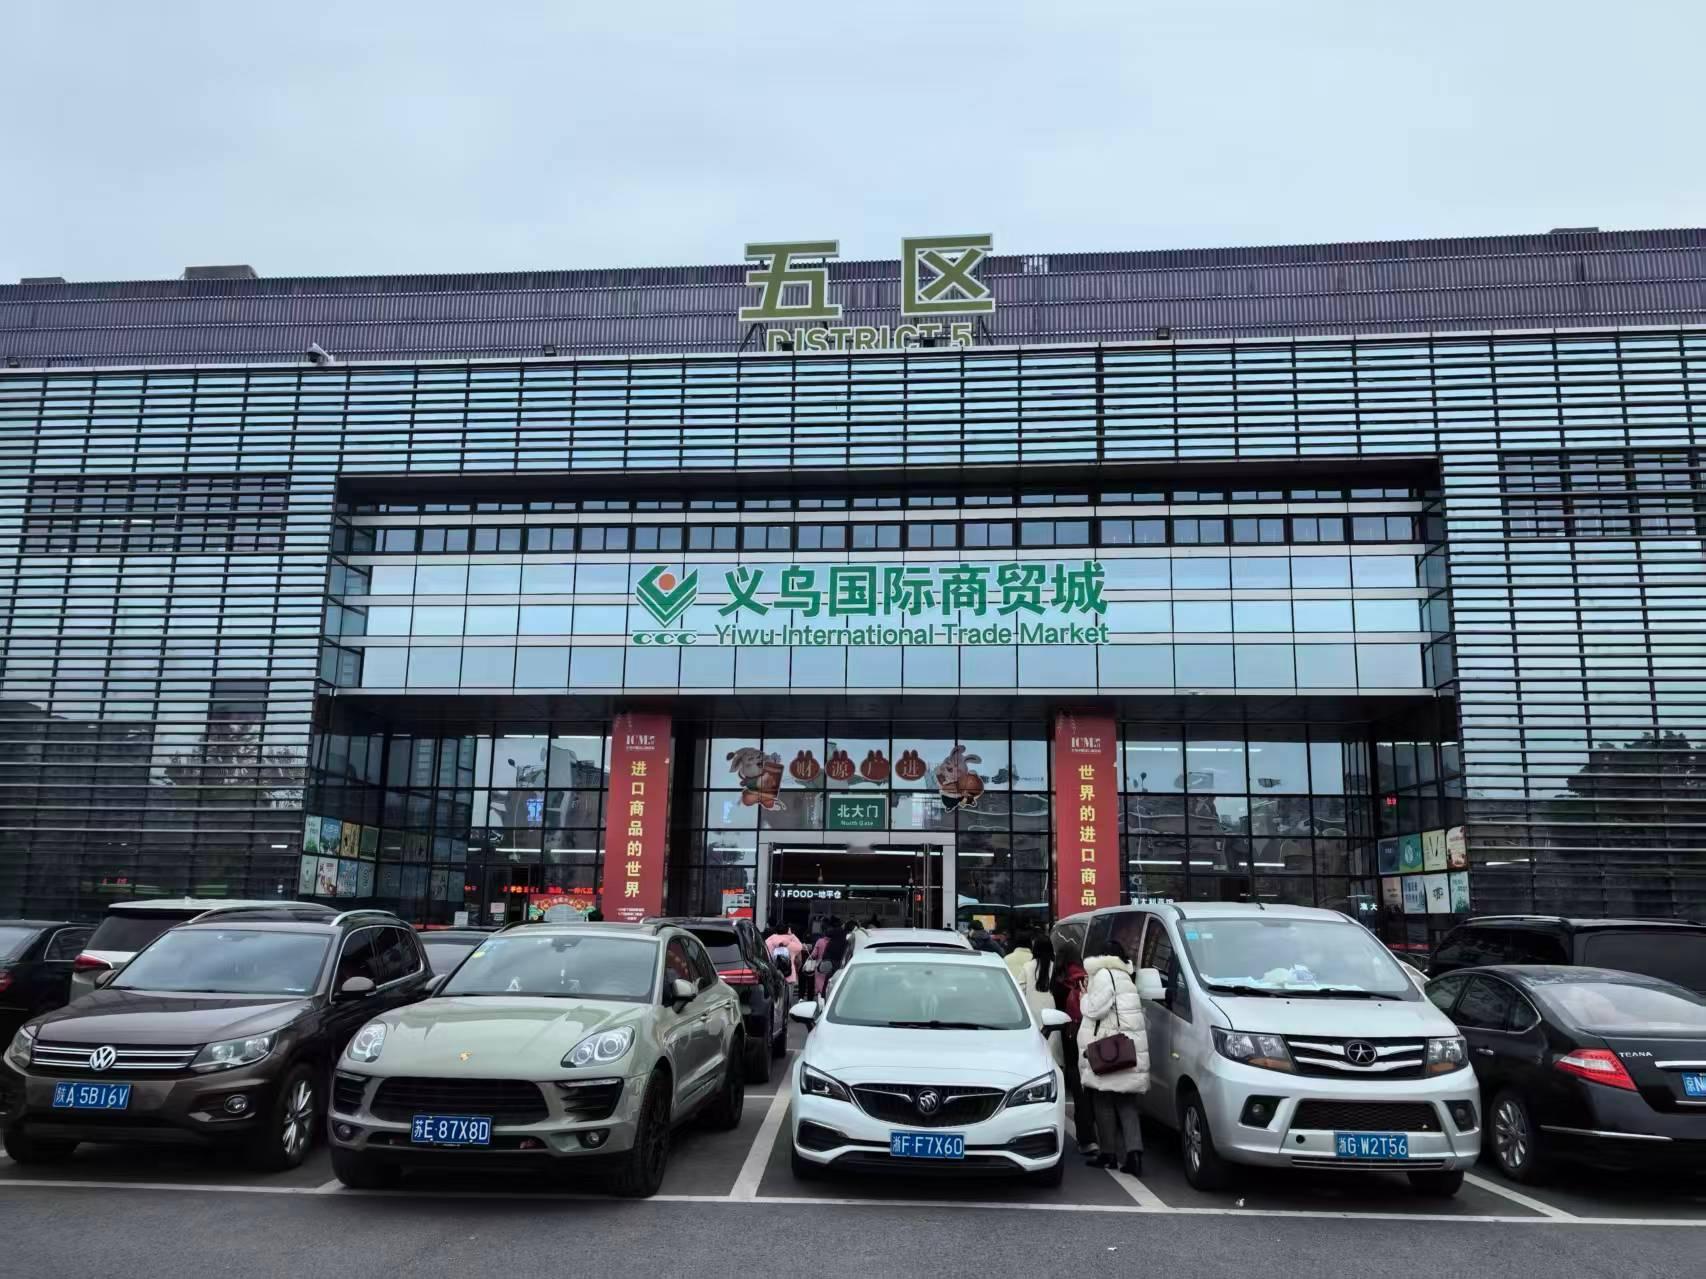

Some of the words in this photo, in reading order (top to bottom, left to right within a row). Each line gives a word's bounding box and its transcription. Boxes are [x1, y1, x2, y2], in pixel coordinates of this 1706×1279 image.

[739, 233, 995, 320] 五区
[767, 323, 942, 352] DISTRICT
[951, 322, 972, 347] 5
[717, 561, 1108, 618] 义乌国际商贸城
[715, 624, 775, 645] Yiwu
[782, 623, 934, 645] International
[941, 623, 1012, 645] Trade
[1020, 622, 1109, 644] Market
[624, 760, 647, 898] 进口商品的世界
[837, 804, 879, 818] 北大门
[1078, 764, 1097, 906] 世界的进口商品
